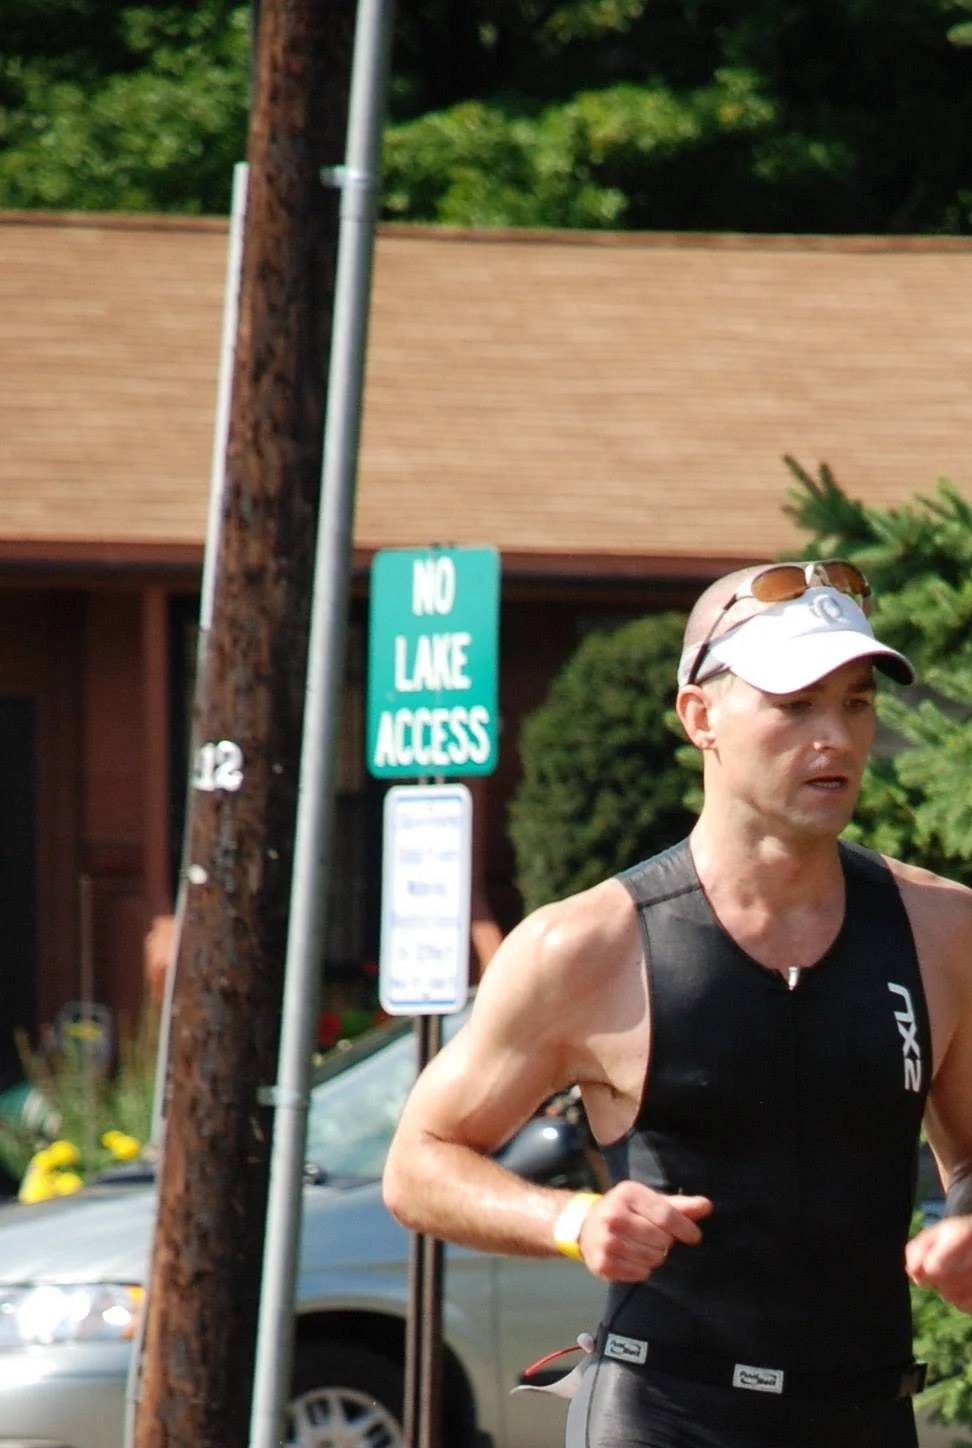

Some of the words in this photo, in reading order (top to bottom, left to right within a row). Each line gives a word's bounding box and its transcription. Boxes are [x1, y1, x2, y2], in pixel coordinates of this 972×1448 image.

[412, 557, 456, 616] NO
[394, 632, 472, 692] LAKE
[193, 740, 244, 792] 12
[373, 705, 491, 768] ACCESS
[887, 981, 922, 1093] 2XU
